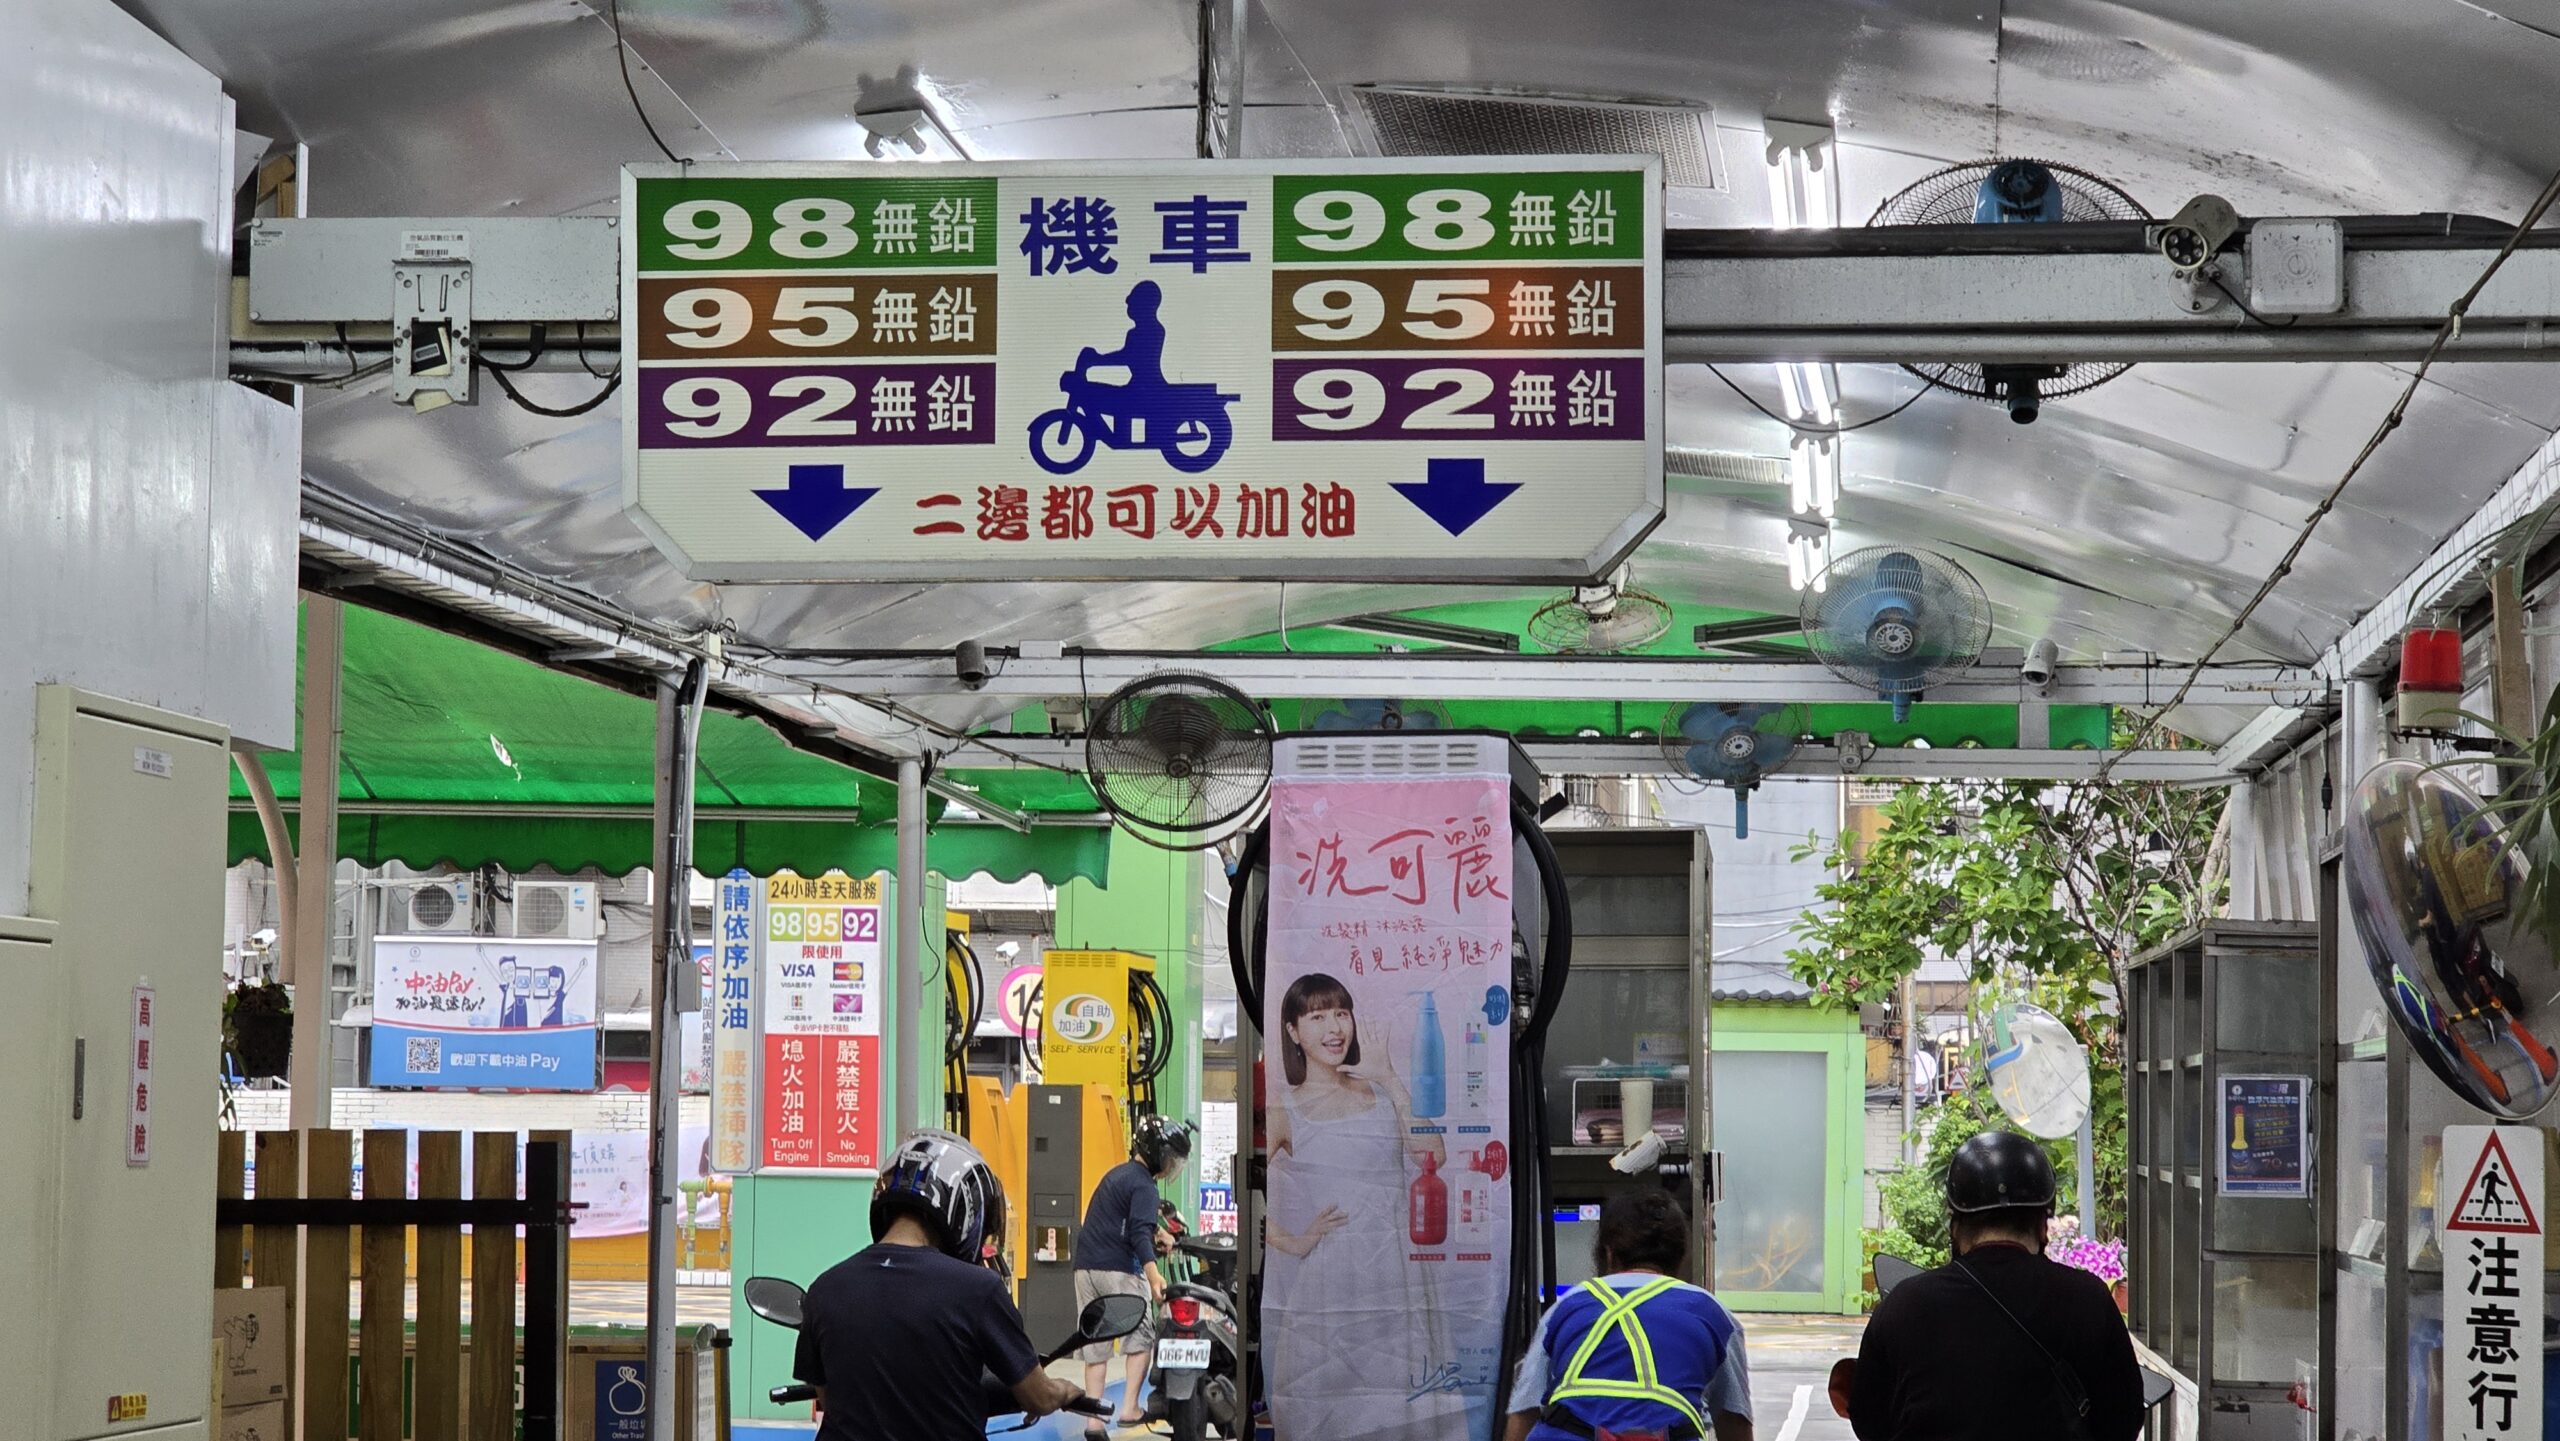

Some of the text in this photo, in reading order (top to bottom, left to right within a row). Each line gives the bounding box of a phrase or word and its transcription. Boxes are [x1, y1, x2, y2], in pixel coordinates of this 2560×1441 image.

[1019, 195, 1250, 277] 機車
[912, 483, 1355, 542] 二邊都可以加油
[1296, 816, 1509, 914] 洗可麗
[771, 880, 877, 900] 24小時全天服務
[772, 911, 802, 936] 98
[807, 912, 839, 937] 95
[843, 912, 875, 938] 92
[802, 945, 843, 959] 限使用
[781, 964, 816, 977] VISA
[1082, 1004, 1111, 1018] 自助
[1058, 1019, 1086, 1033] 加油
[1050, 1045, 1116, 1054] SELF SERVICE
[530, 1053, 561, 1072] Pay
[133, 995, 151, 1155] 高壓危險
[781, 1039, 805, 1134] 熄火加油
[836, 1040, 860, 1134] 嚴禁煙火
[719, 1051, 748, 1167] 嚴禁插隊
[771, 1138, 813, 1150] Turn Off
[840, 1140, 856, 1151] No
[774, 1151, 809, 1163] Engine
[826, 1152, 870, 1165] Smoking
[2466, 1236, 2521, 1441] 注意行
[612, 1432, 629, 1440] Other
